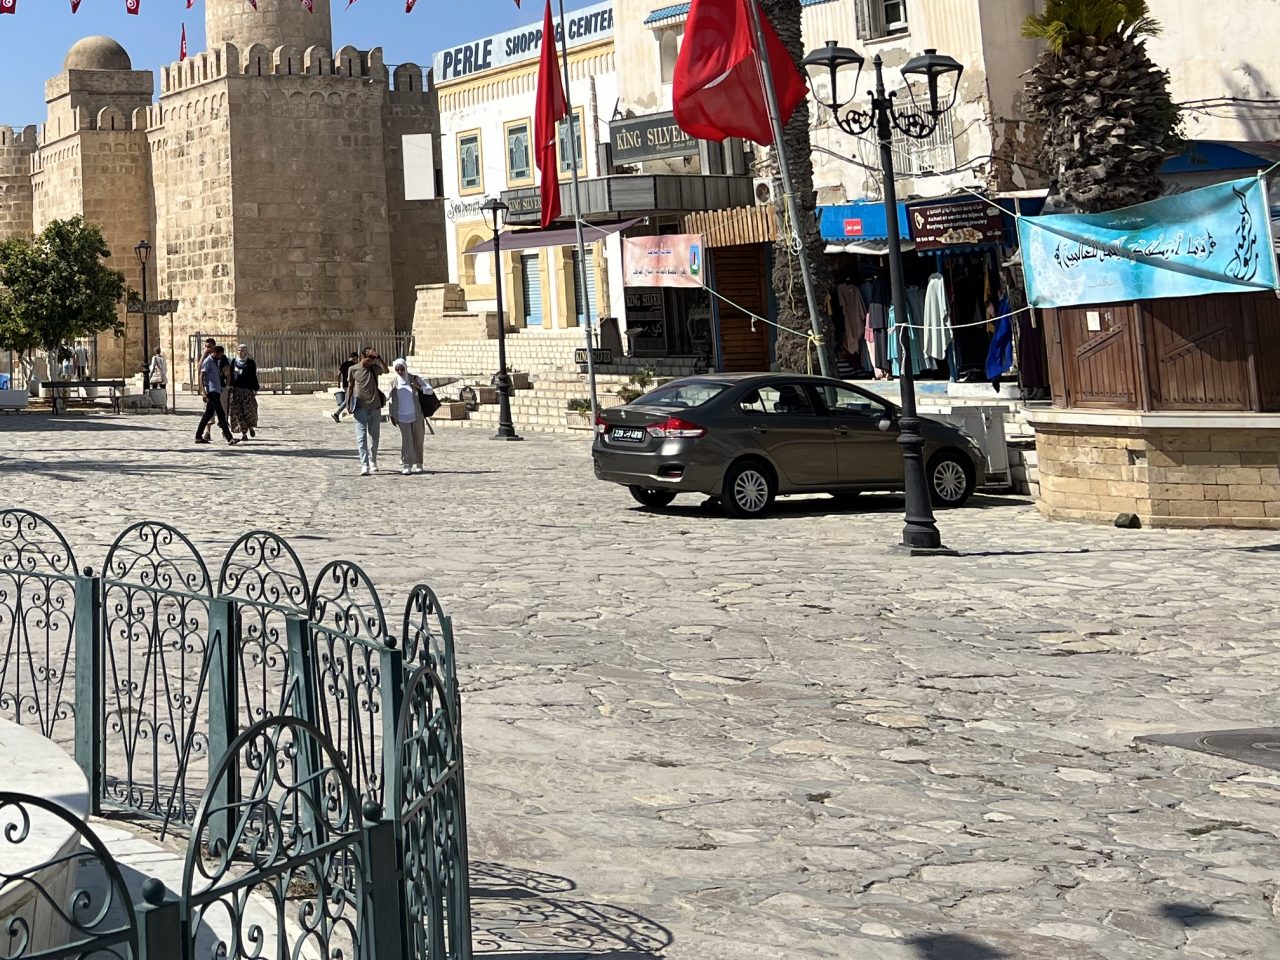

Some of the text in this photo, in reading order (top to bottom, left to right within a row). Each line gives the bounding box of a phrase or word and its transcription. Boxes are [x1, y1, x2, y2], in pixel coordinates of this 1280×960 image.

[443, 39, 492, 81] PERLE
[505, 22, 564, 57] SHOPPG
[616, 130, 641, 150] KING
